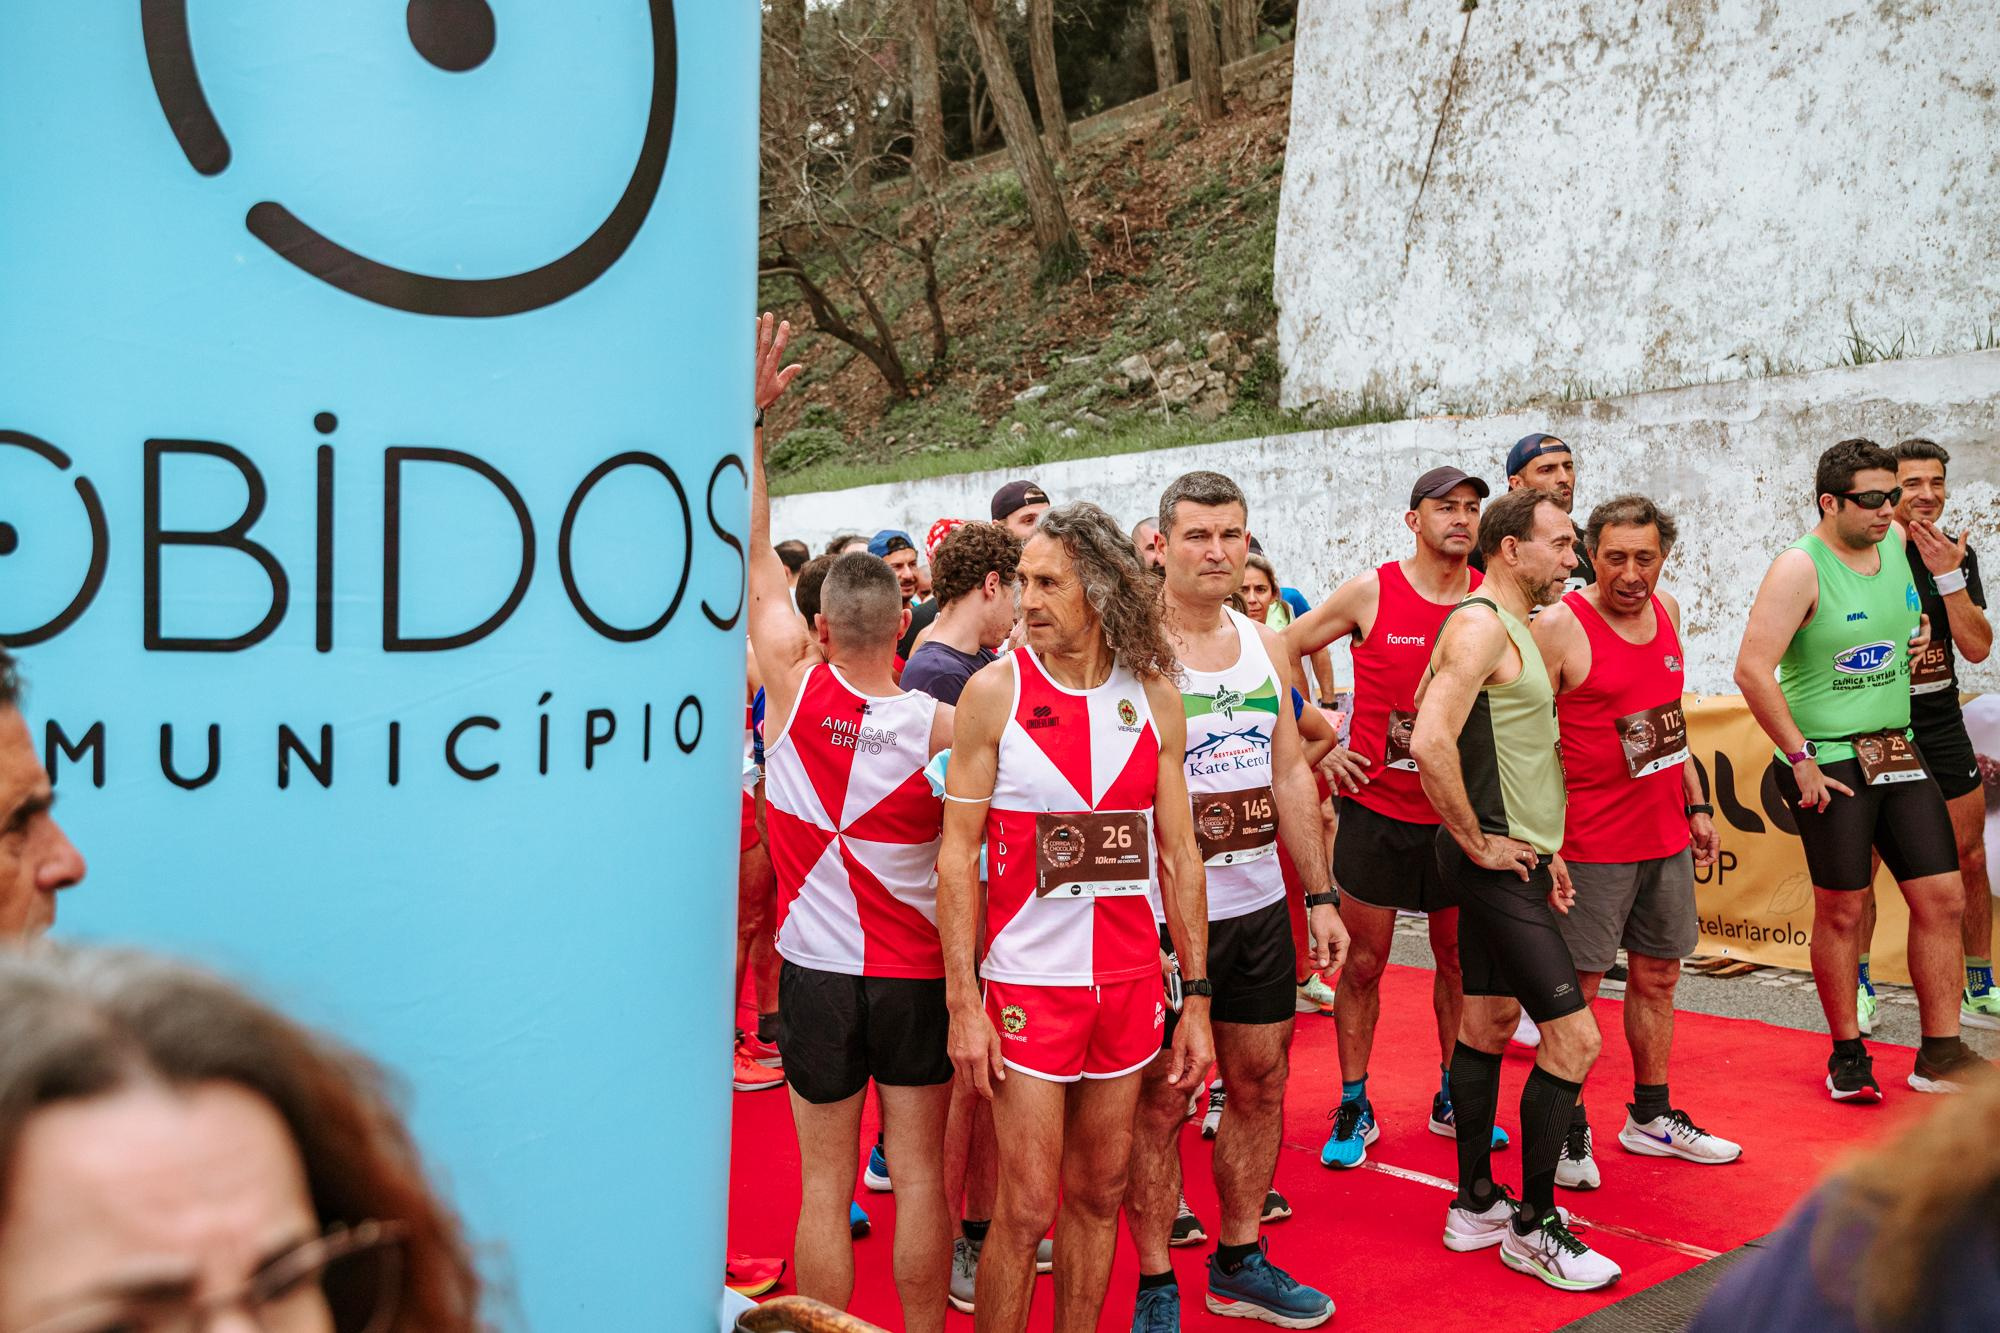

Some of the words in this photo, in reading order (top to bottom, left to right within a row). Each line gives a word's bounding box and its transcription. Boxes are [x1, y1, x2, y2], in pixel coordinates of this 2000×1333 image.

[1860, 649, 1879, 667] DL
[45, 691, 703, 790] MUNICÍPIO
[831, 732, 882, 755] BRITO
[1886, 736, 1906, 750] 25
[1213, 747, 1254, 760] RESTAURANTE
[1189, 761, 1230, 777] Kate
[1233, 755, 1265, 770] Kero
[1242, 798, 1272, 821] 145
[1102, 825, 1132, 849] 26
[1095, 856, 1117, 865] 10km
